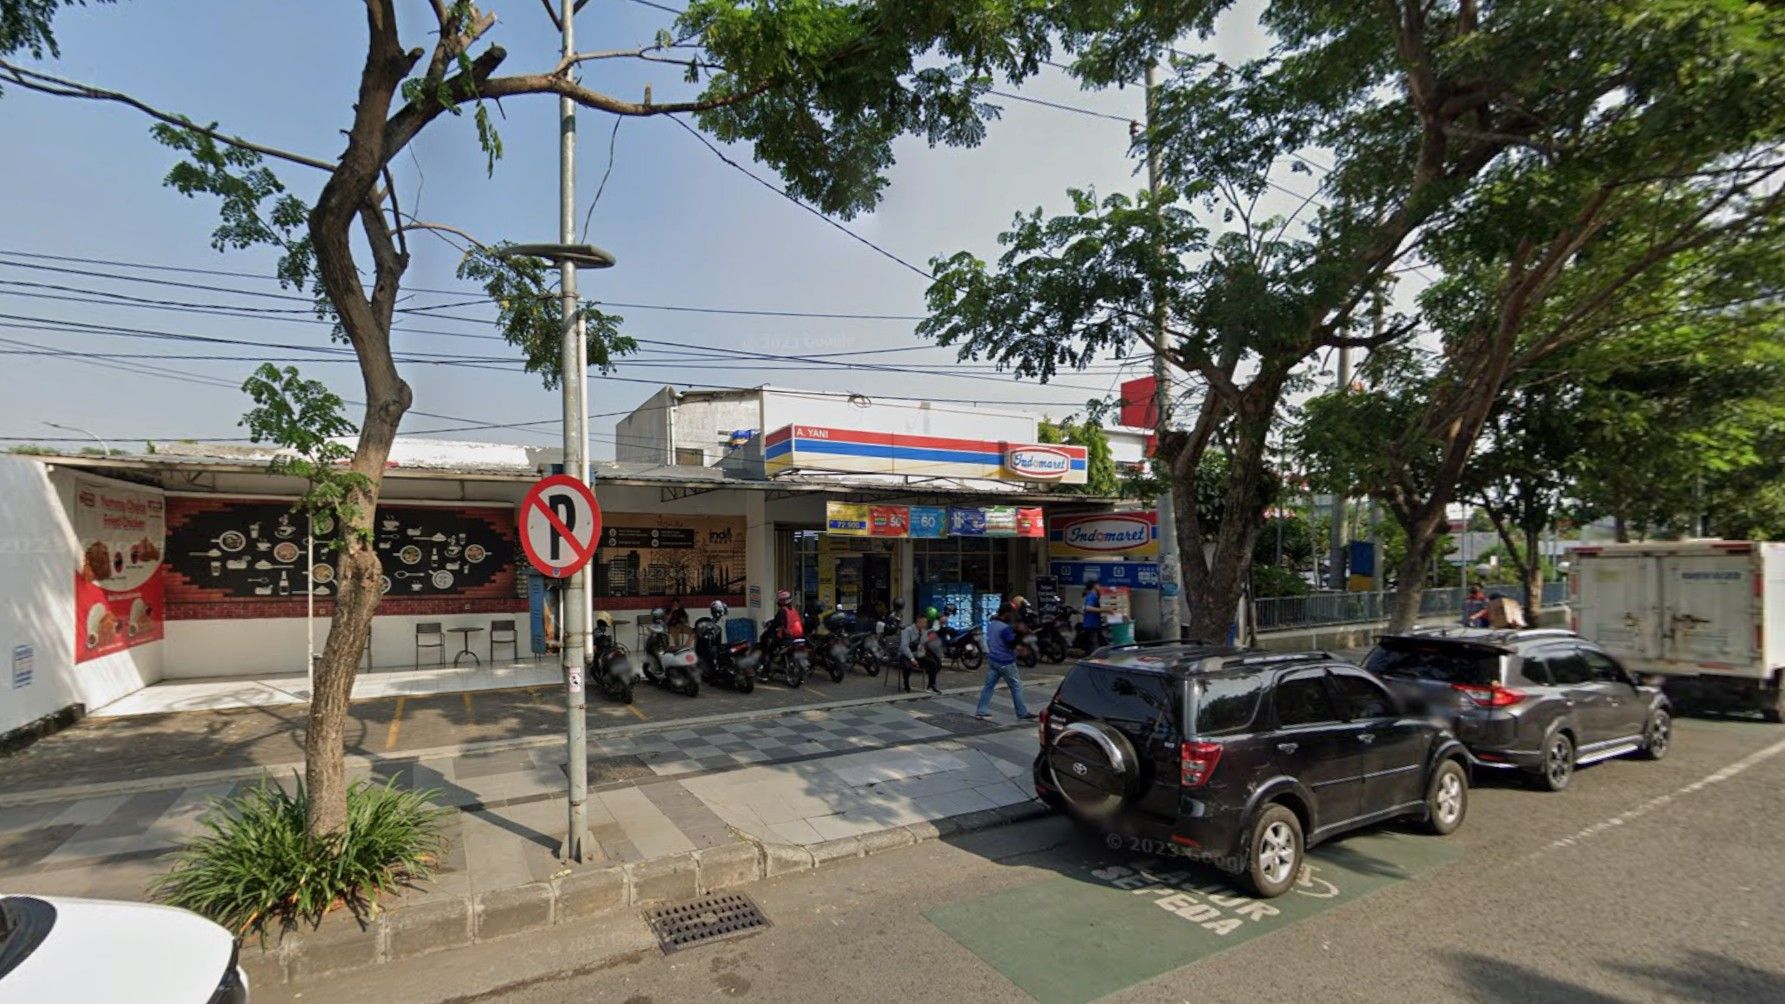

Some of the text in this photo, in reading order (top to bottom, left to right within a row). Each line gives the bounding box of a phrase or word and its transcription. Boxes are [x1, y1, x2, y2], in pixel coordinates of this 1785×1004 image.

[807, 429, 829, 439] YANI
[1013, 454, 1065, 469] Indomaret
[548, 493, 576, 561] P
[921, 516, 936, 528] 60
[1070, 527, 1145, 542] Indomaret
